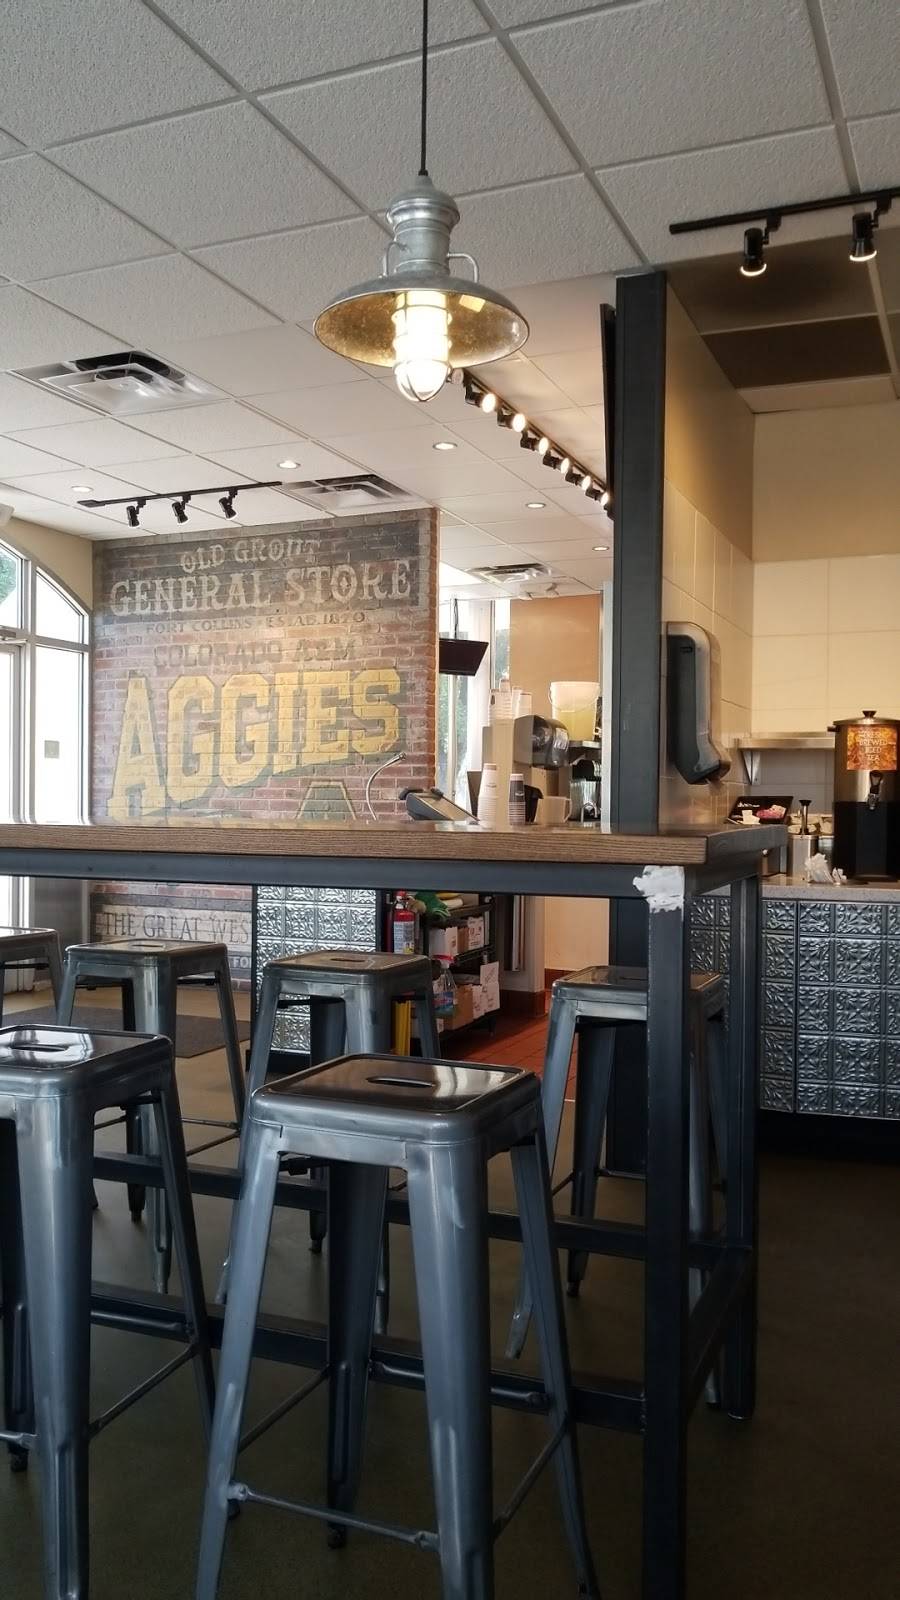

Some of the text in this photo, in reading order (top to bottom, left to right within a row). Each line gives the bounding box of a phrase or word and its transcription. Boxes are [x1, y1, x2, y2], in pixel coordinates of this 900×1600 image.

[181, 536, 321, 573] OLD GROUT
[109, 560, 411, 616] GENERAL STORE
[146, 621, 185, 634] FORT
[191, 618, 252, 632] COLLINS
[266, 614, 320, 627] ESAB.
[107, 667, 404, 820] AGGIES
[103, 912, 251, 944] THE GREAT WES
